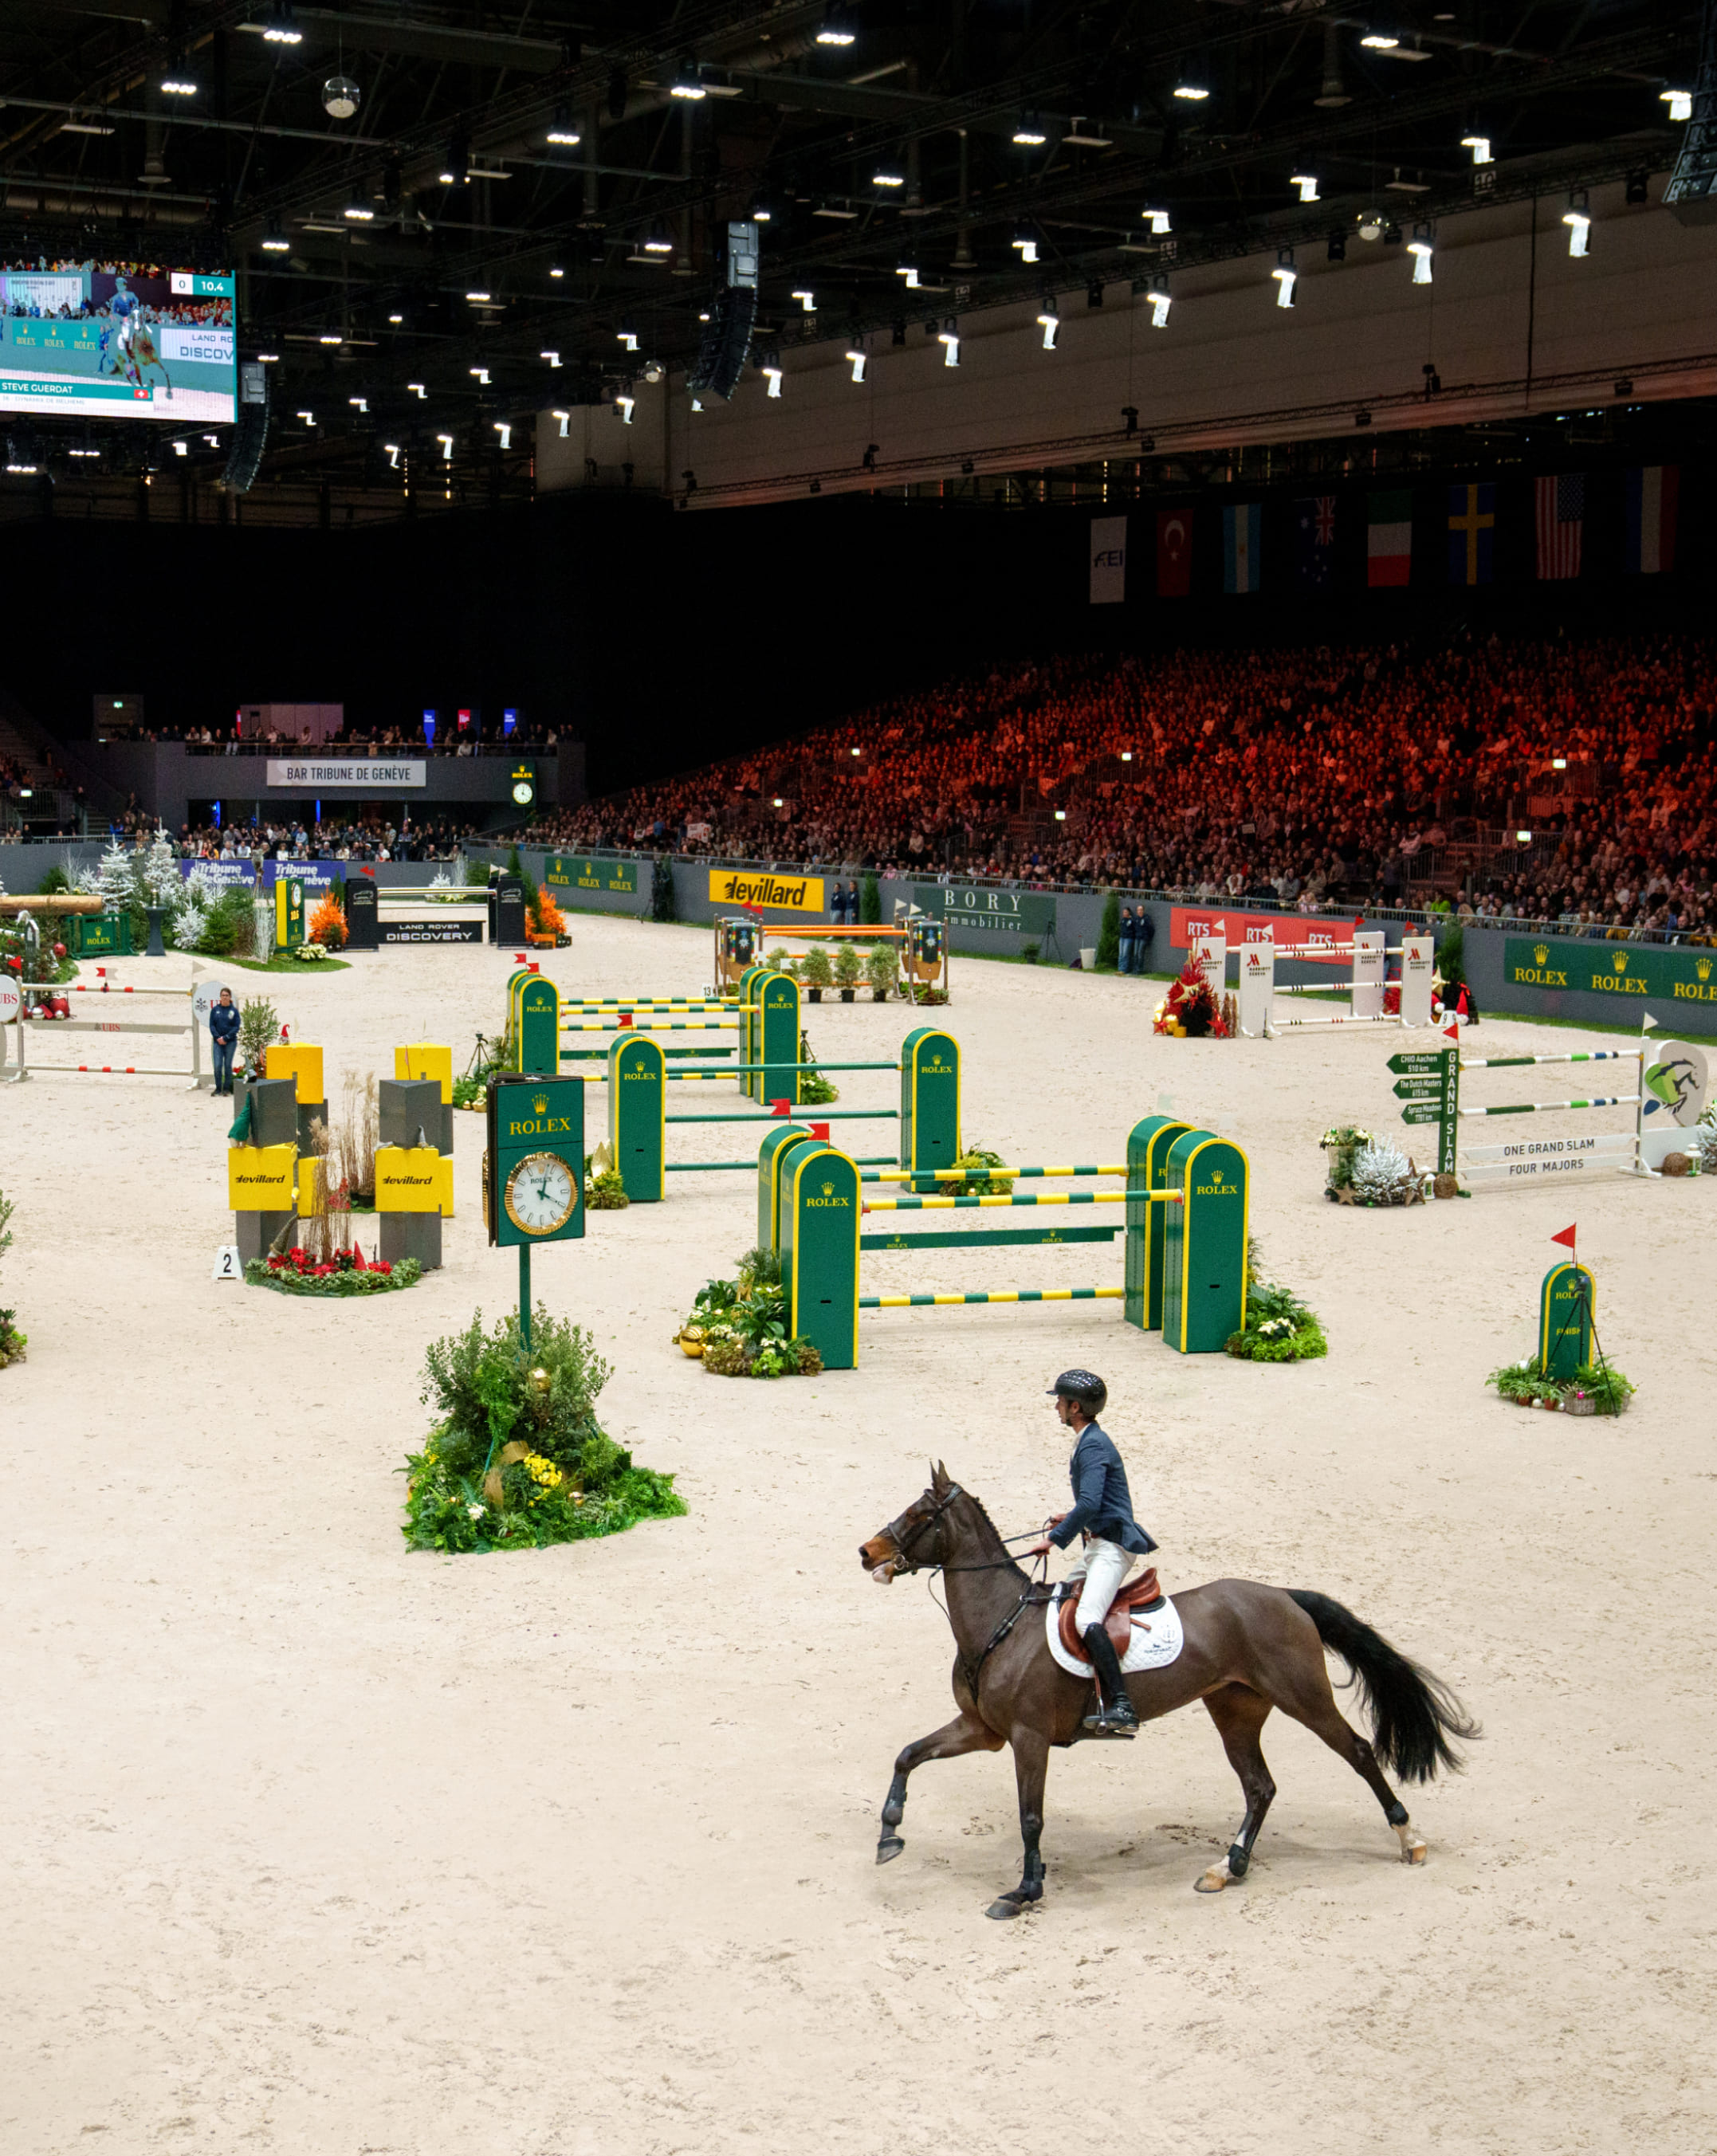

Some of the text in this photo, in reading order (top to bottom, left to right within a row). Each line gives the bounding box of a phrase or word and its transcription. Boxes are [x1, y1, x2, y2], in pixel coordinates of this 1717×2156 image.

[179, 281, 186, 289] 0
[201, 281, 224, 292] 10.4
[16, 336, 96, 351] ROLEX ROLEX ROLEX
[2, 382, 73, 394] STEVE GUERDAT
[1094, 550, 1123, 568] FEI
[287, 764, 411, 781] BAR TRIBUNE DE GENÈVE
[198, 862, 242, 874] Tribune
[275, 863, 318, 874] Tribune
[548, 874, 632, 891] ROLEX ROLEX ROLEX
[725, 875, 807, 906] devillard
[945, 889, 1020, 911] BORY
[944, 913, 1021, 931] mmobilier
[386, 932, 472, 941] DISCOVERY
[1187, 921, 1210, 937] RTS
[1246, 927, 1269, 942] RTS
[87, 937, 111, 945] ROLEX
[1515, 967, 1567, 987] ROLEX
[1591, 974, 1648, 995] ROLEX
[704, 987, 711, 996] 13
[102, 1022, 120, 1032] UBS
[1416, 1054, 1438, 1063] Aachen
[1400, 1078, 1442, 1089] The Dutch Masters
[1444, 1051, 1457, 1173] GRAND SLAM
[509, 1117, 572, 1136] ROLEX
[1503, 1138, 1594, 1157] ONE GRAND SLAM
[1509, 1159, 1584, 1176] FOUR MAJORS
[235, 1174, 285, 1184] devillard
[383, 1175, 433, 1184] devillard
[1196, 1185, 1238, 1195] ROLEX
[806, 1197, 850, 1208] ROLEX
[222, 1253, 231, 1273] 2
